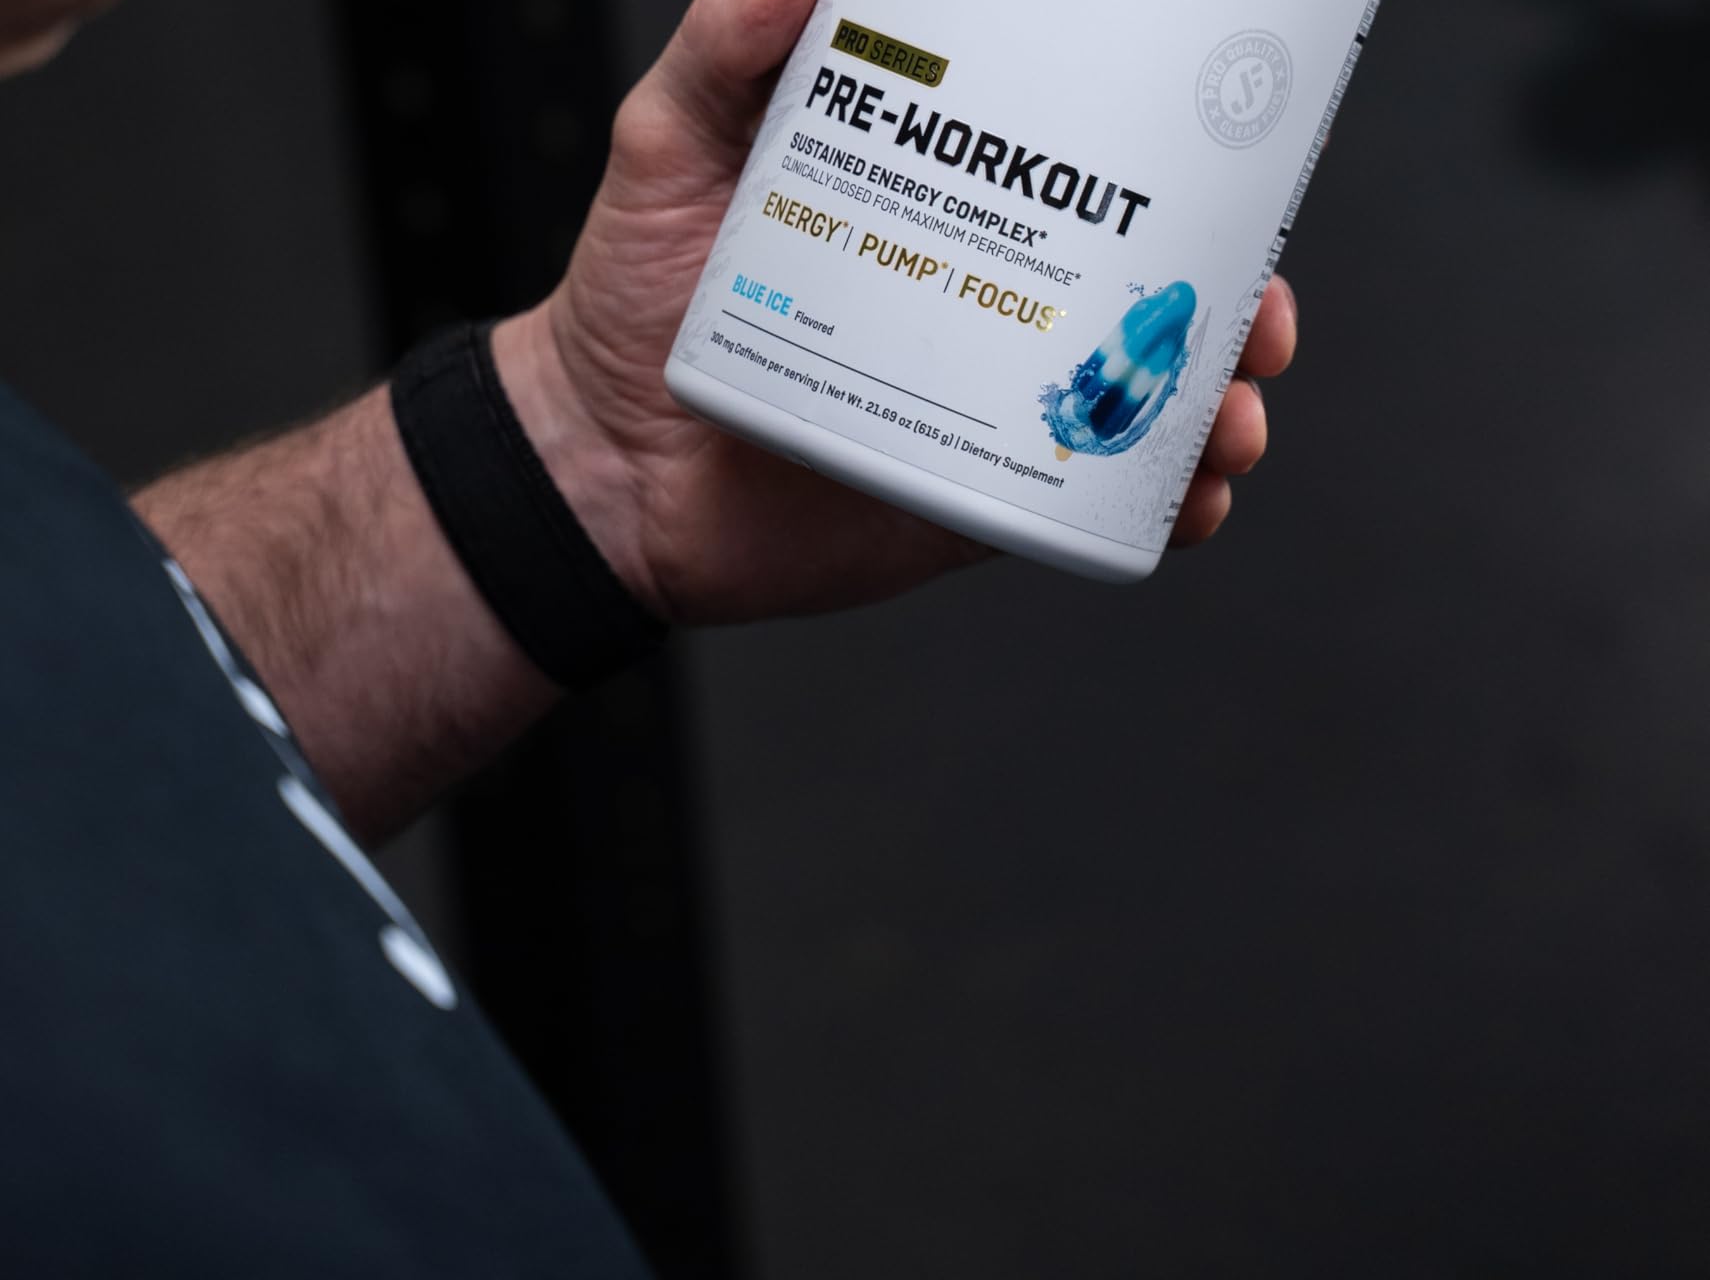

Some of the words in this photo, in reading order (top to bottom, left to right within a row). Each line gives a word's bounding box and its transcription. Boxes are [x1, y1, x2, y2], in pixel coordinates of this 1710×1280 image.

[834, 24, 870, 55] PRO
[870, 39, 942, 83] SERIES
[790, 132, 867, 177] SUSTAINED
[866, 163, 943, 207] ENERGY
[805, 66, 1150, 238] PRE-WORKOUT
[781, 155, 833, 187] CLINICALLY
[831, 176, 873, 204] DOSED
[872, 194, 900, 216] FOR
[900, 205, 967, 244] MAXIMUM
[732, 273, 767, 305] BLUE
[764, 289, 793, 317] ICE
[794, 310, 835, 337] Flavored
[710, 331, 724, 346] 300
[722, 339, 735, 354] mg
[734, 340, 768, 367] Caffeine
[766, 358, 784, 373] per
[784, 365, 820, 393] serving
[826, 384, 846, 402] Net
[846, 392, 864, 410] Wt.
[865, 400, 898, 422] 21.69
[898, 416, 913, 430] oz
[913, 419, 941, 441] (615
[940, 432, 956, 447] g)
[960, 439, 1003, 467] Dietary
[1002, 456, 1066, 490] Supplement
